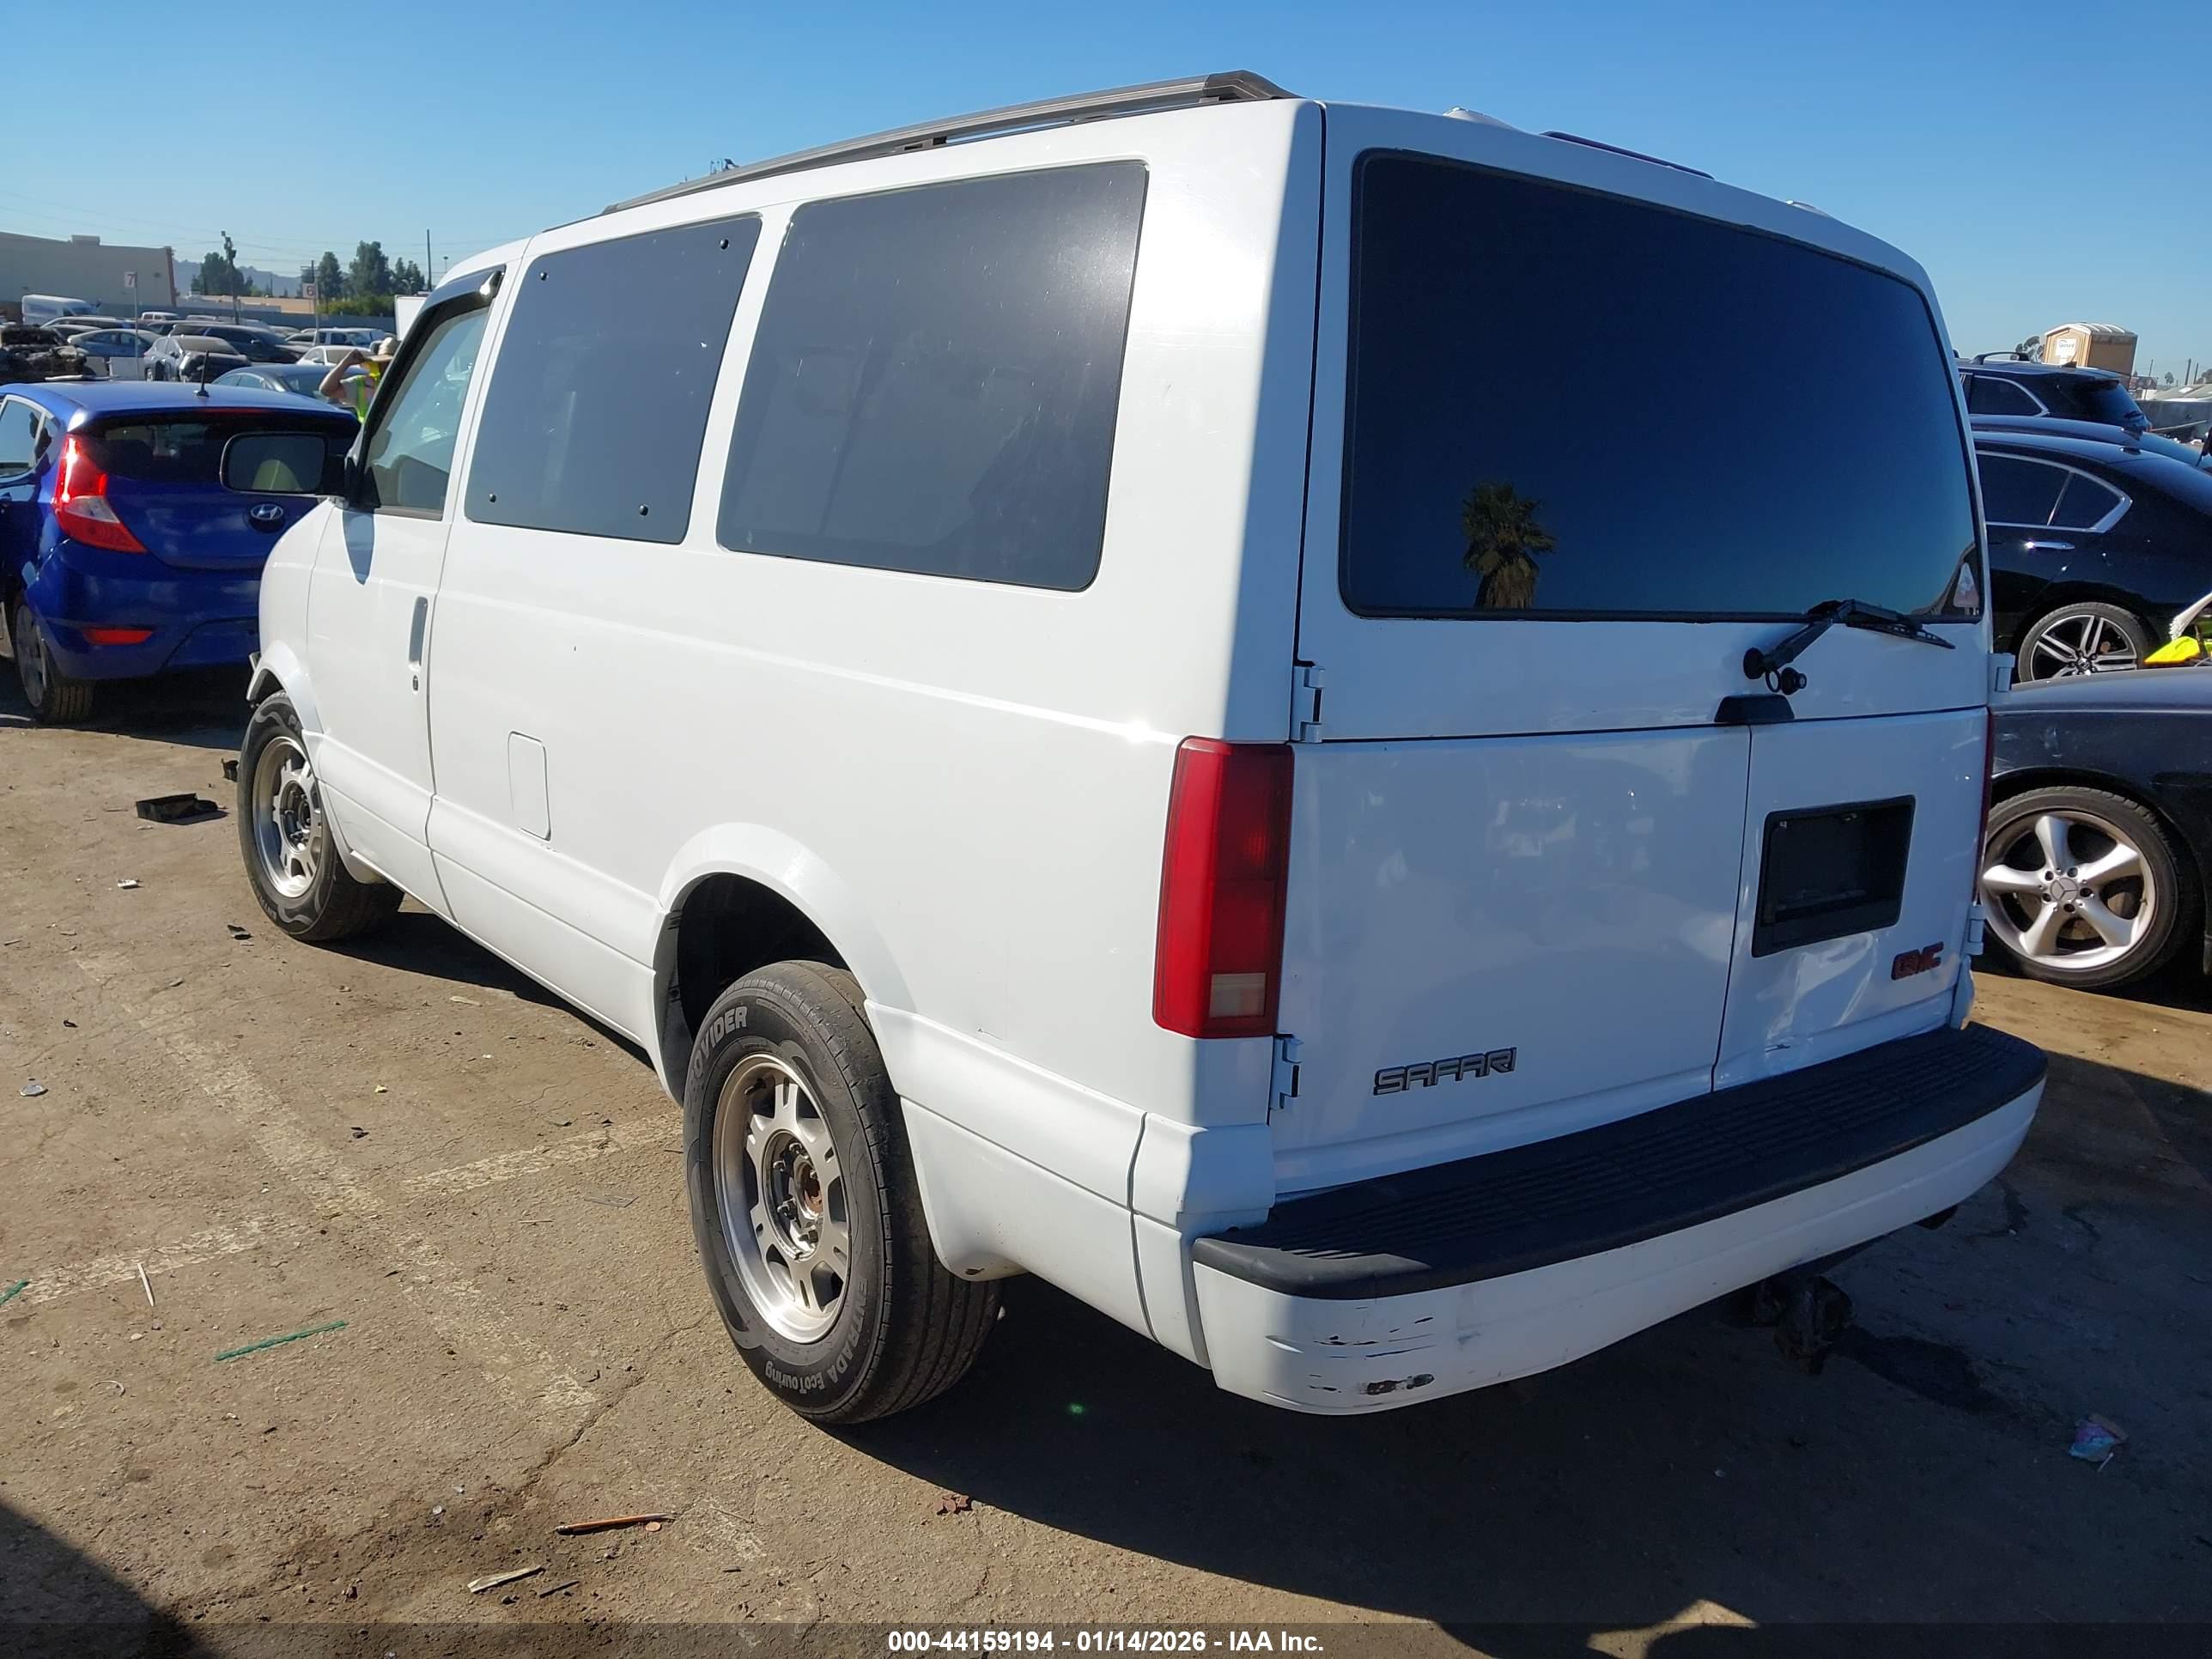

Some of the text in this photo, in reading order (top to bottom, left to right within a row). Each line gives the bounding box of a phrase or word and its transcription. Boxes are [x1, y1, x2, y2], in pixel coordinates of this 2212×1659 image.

[306, 285, 314, 296] 6
[690, 1006, 748, 1091] OVIDER
[1373, 1047, 1517, 1096] SAFARI
[765, 1361, 825, 1395] EcoTouring
